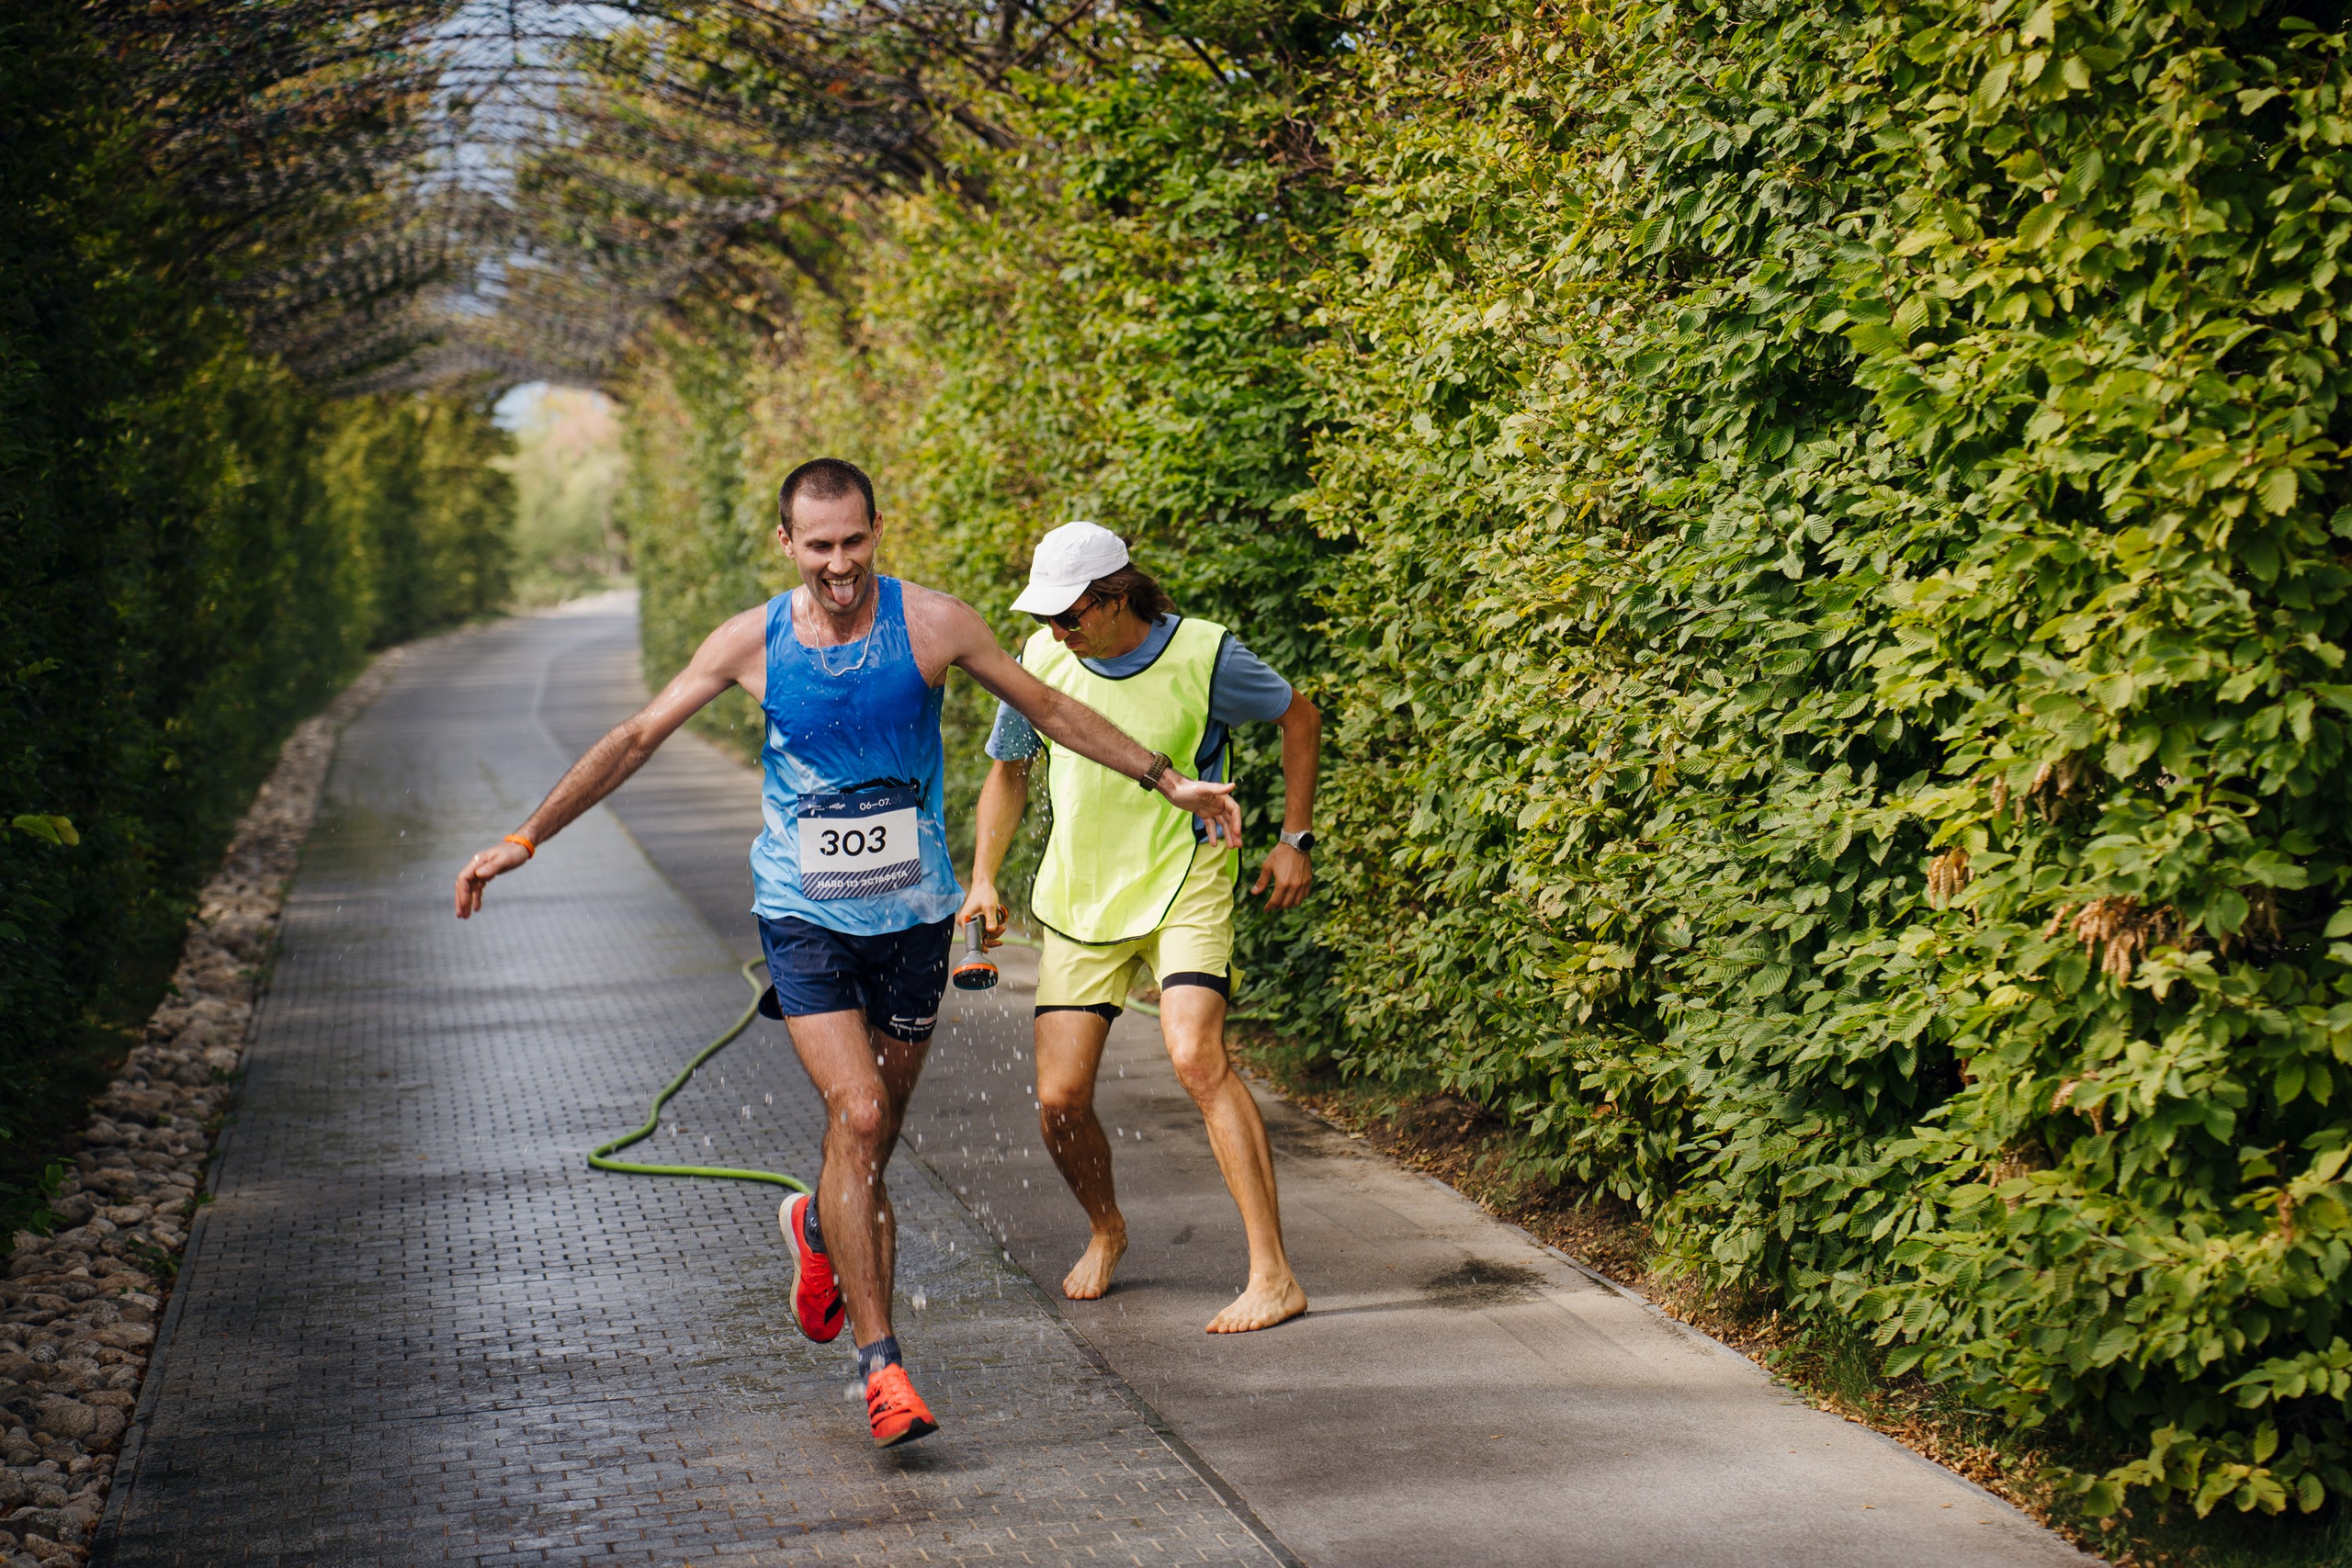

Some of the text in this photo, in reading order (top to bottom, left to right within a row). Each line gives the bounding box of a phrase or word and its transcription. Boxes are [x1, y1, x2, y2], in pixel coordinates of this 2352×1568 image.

[820, 825, 887, 857] 303
[818, 870, 909, 889] HARD 113 ЭСТАФЕТА
